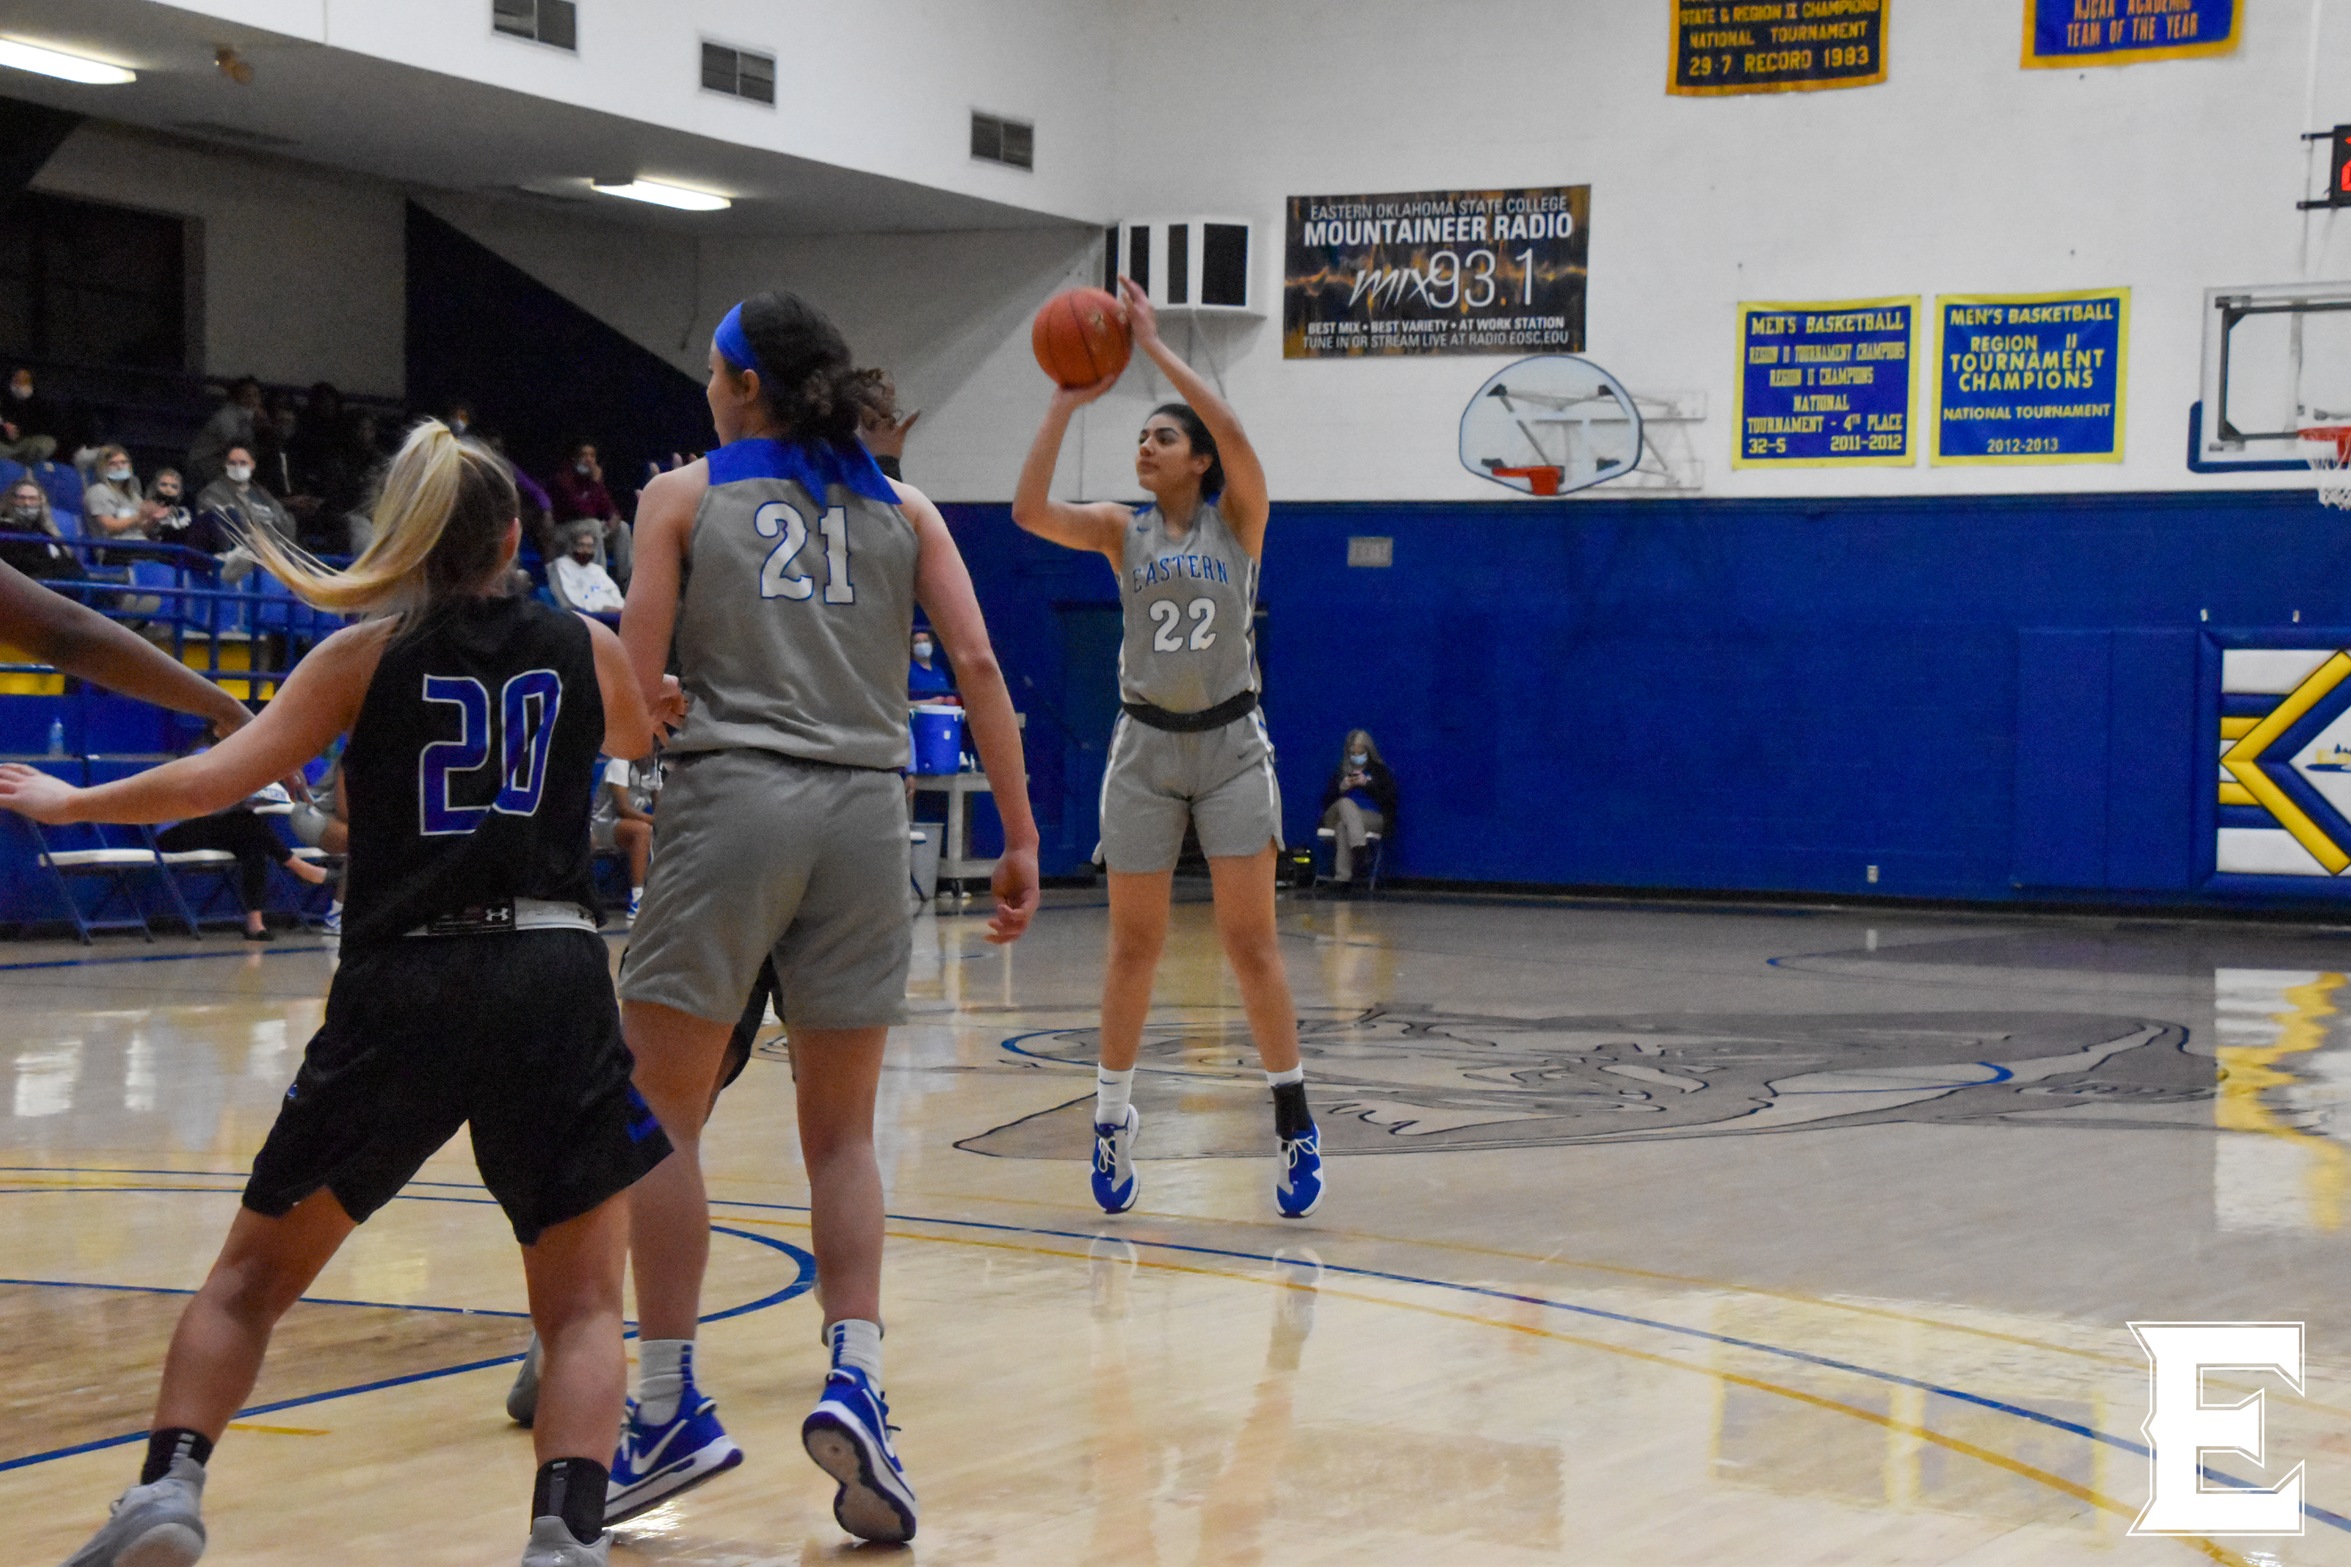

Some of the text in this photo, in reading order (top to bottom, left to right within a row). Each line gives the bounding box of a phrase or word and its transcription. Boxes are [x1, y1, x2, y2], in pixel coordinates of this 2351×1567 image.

[1690, 21, 1868, 49] NATIONAL TOURNAMENT
[2067, 12, 2198, 47] TEAM OF THE YEAR
[1744, 49, 1812, 73] RECORD
[1824, 46, 1870, 68] 1983
[1310, 195, 1568, 221] EASTERN OKLAHOMA STATE COLLEGE
[1304, 211, 1573, 247] MOUNTAINEER RADIO
[1307, 316, 1565, 335] BEST MIX BEST VARIETY AT WORK STATION
[1751, 312, 1905, 336] MEN'S BASKETBALL
[1950, 303, 2114, 326] MEN'S BASKETBALL
[1303, 335, 1334, 349] TUNE
[1336, 335, 1349, 348] IN
[1351, 334, 1369, 348] OR
[1371, 334, 1420, 349] STREAM
[1422, 332, 1447, 347] LIVE
[1450, 332, 1465, 346] AT
[1971, 333, 2078, 353] REGION II
[1950, 348, 2105, 373] TOURNAMENT
[1958, 369, 2094, 393] CHAMPIONS
[1793, 393, 1850, 413] NATIONAL
[1943, 403, 2112, 421] NATIONAL TOURNAMENT
[1747, 415, 1825, 434] TOURNAMENT
[1867, 413, 1904, 432] PLACE
[1829, 434, 1903, 452] 2011-2012
[1986, 437, 2060, 453] 2012-2013
[754, 500, 855, 605] 21
[1132, 554, 1230, 594] EASTERN
[1149, 597, 1217, 652] 22
[419, 667, 563, 836] 20
